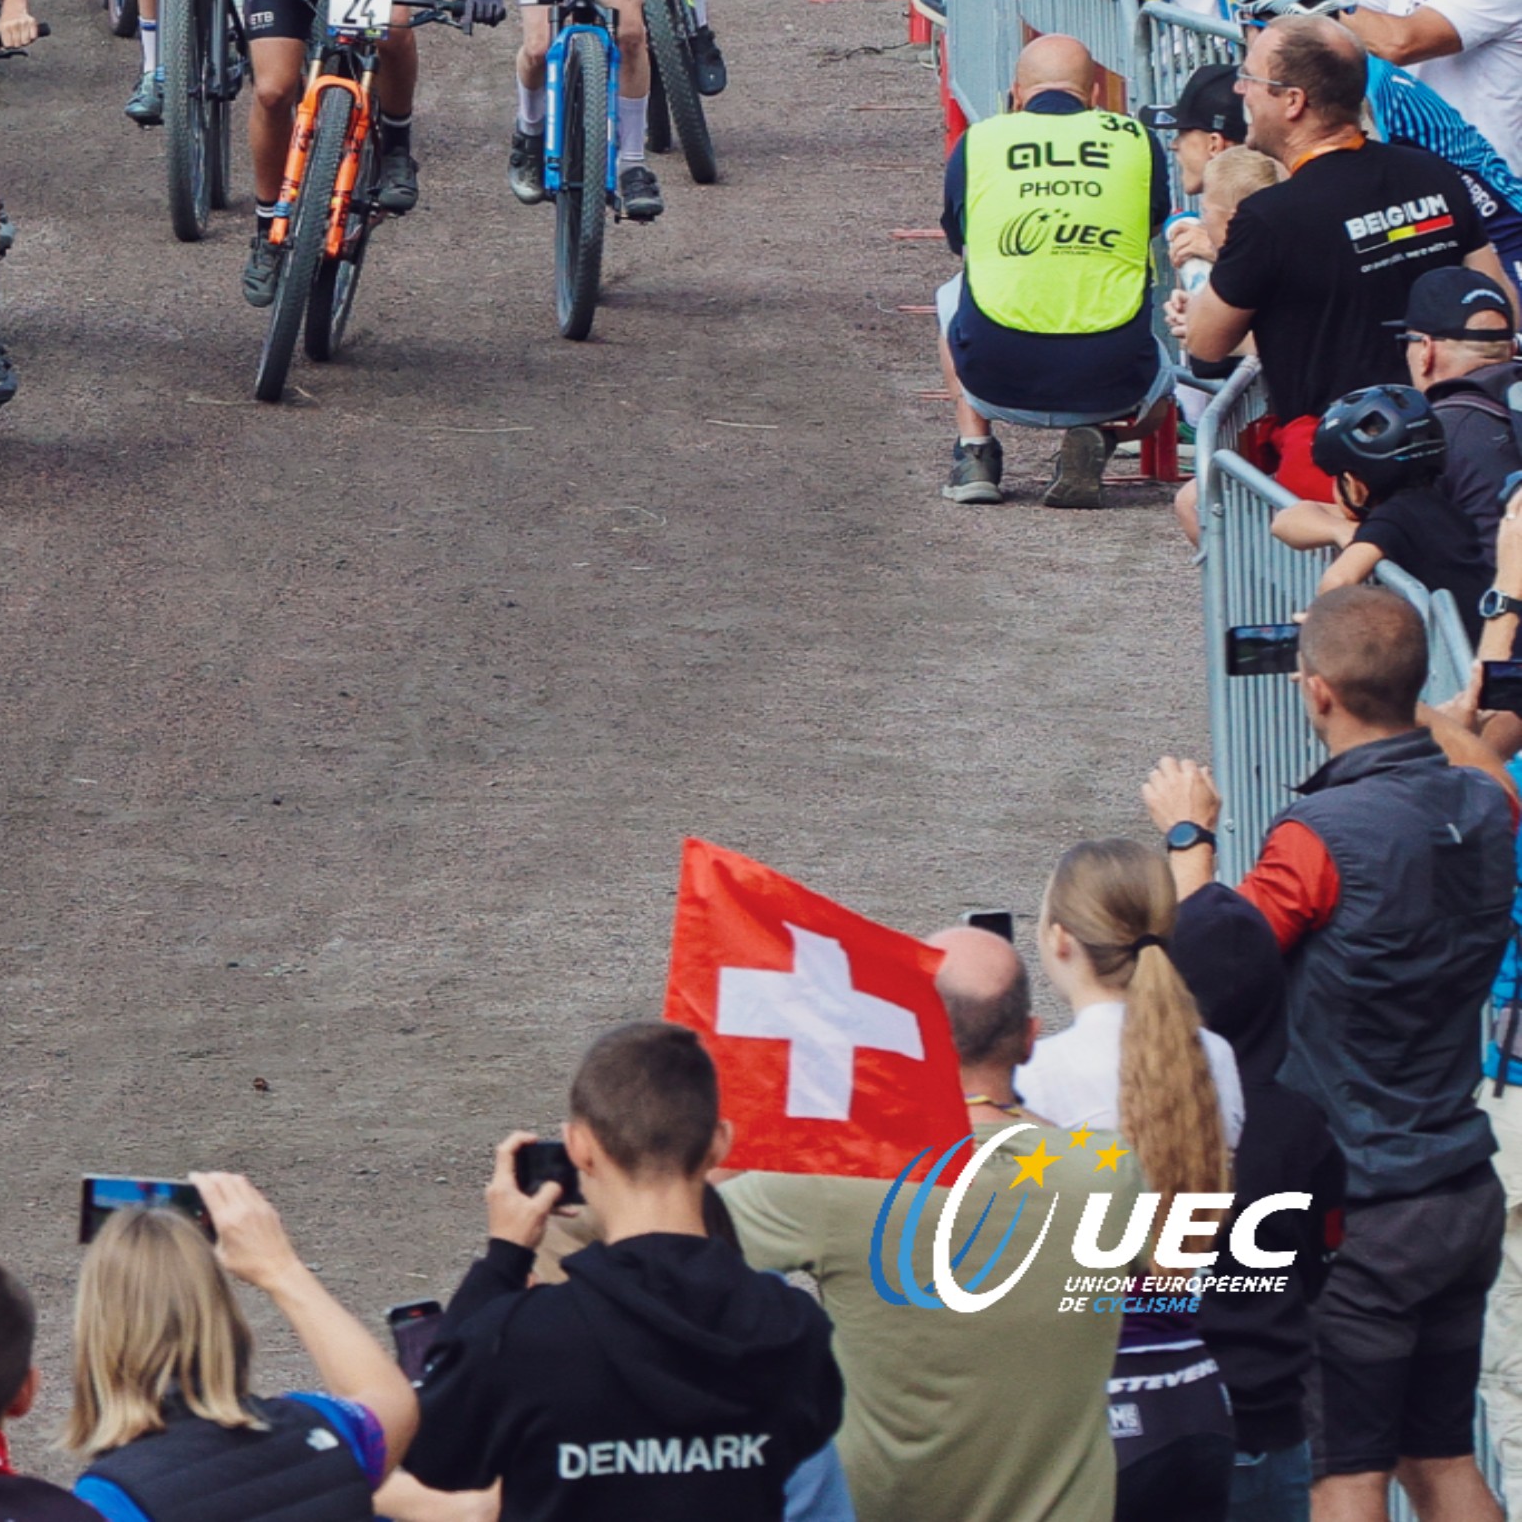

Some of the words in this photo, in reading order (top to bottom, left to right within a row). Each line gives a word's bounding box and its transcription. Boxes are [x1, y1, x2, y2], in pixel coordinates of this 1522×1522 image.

[1101, 115, 1142, 140] 34
[1019, 179, 1103, 198] PHOTO
[1344, 192, 1450, 242] BELGIUM
[1054, 223, 1122, 249] UEC
[558, 1433, 772, 1480] DENMARK
